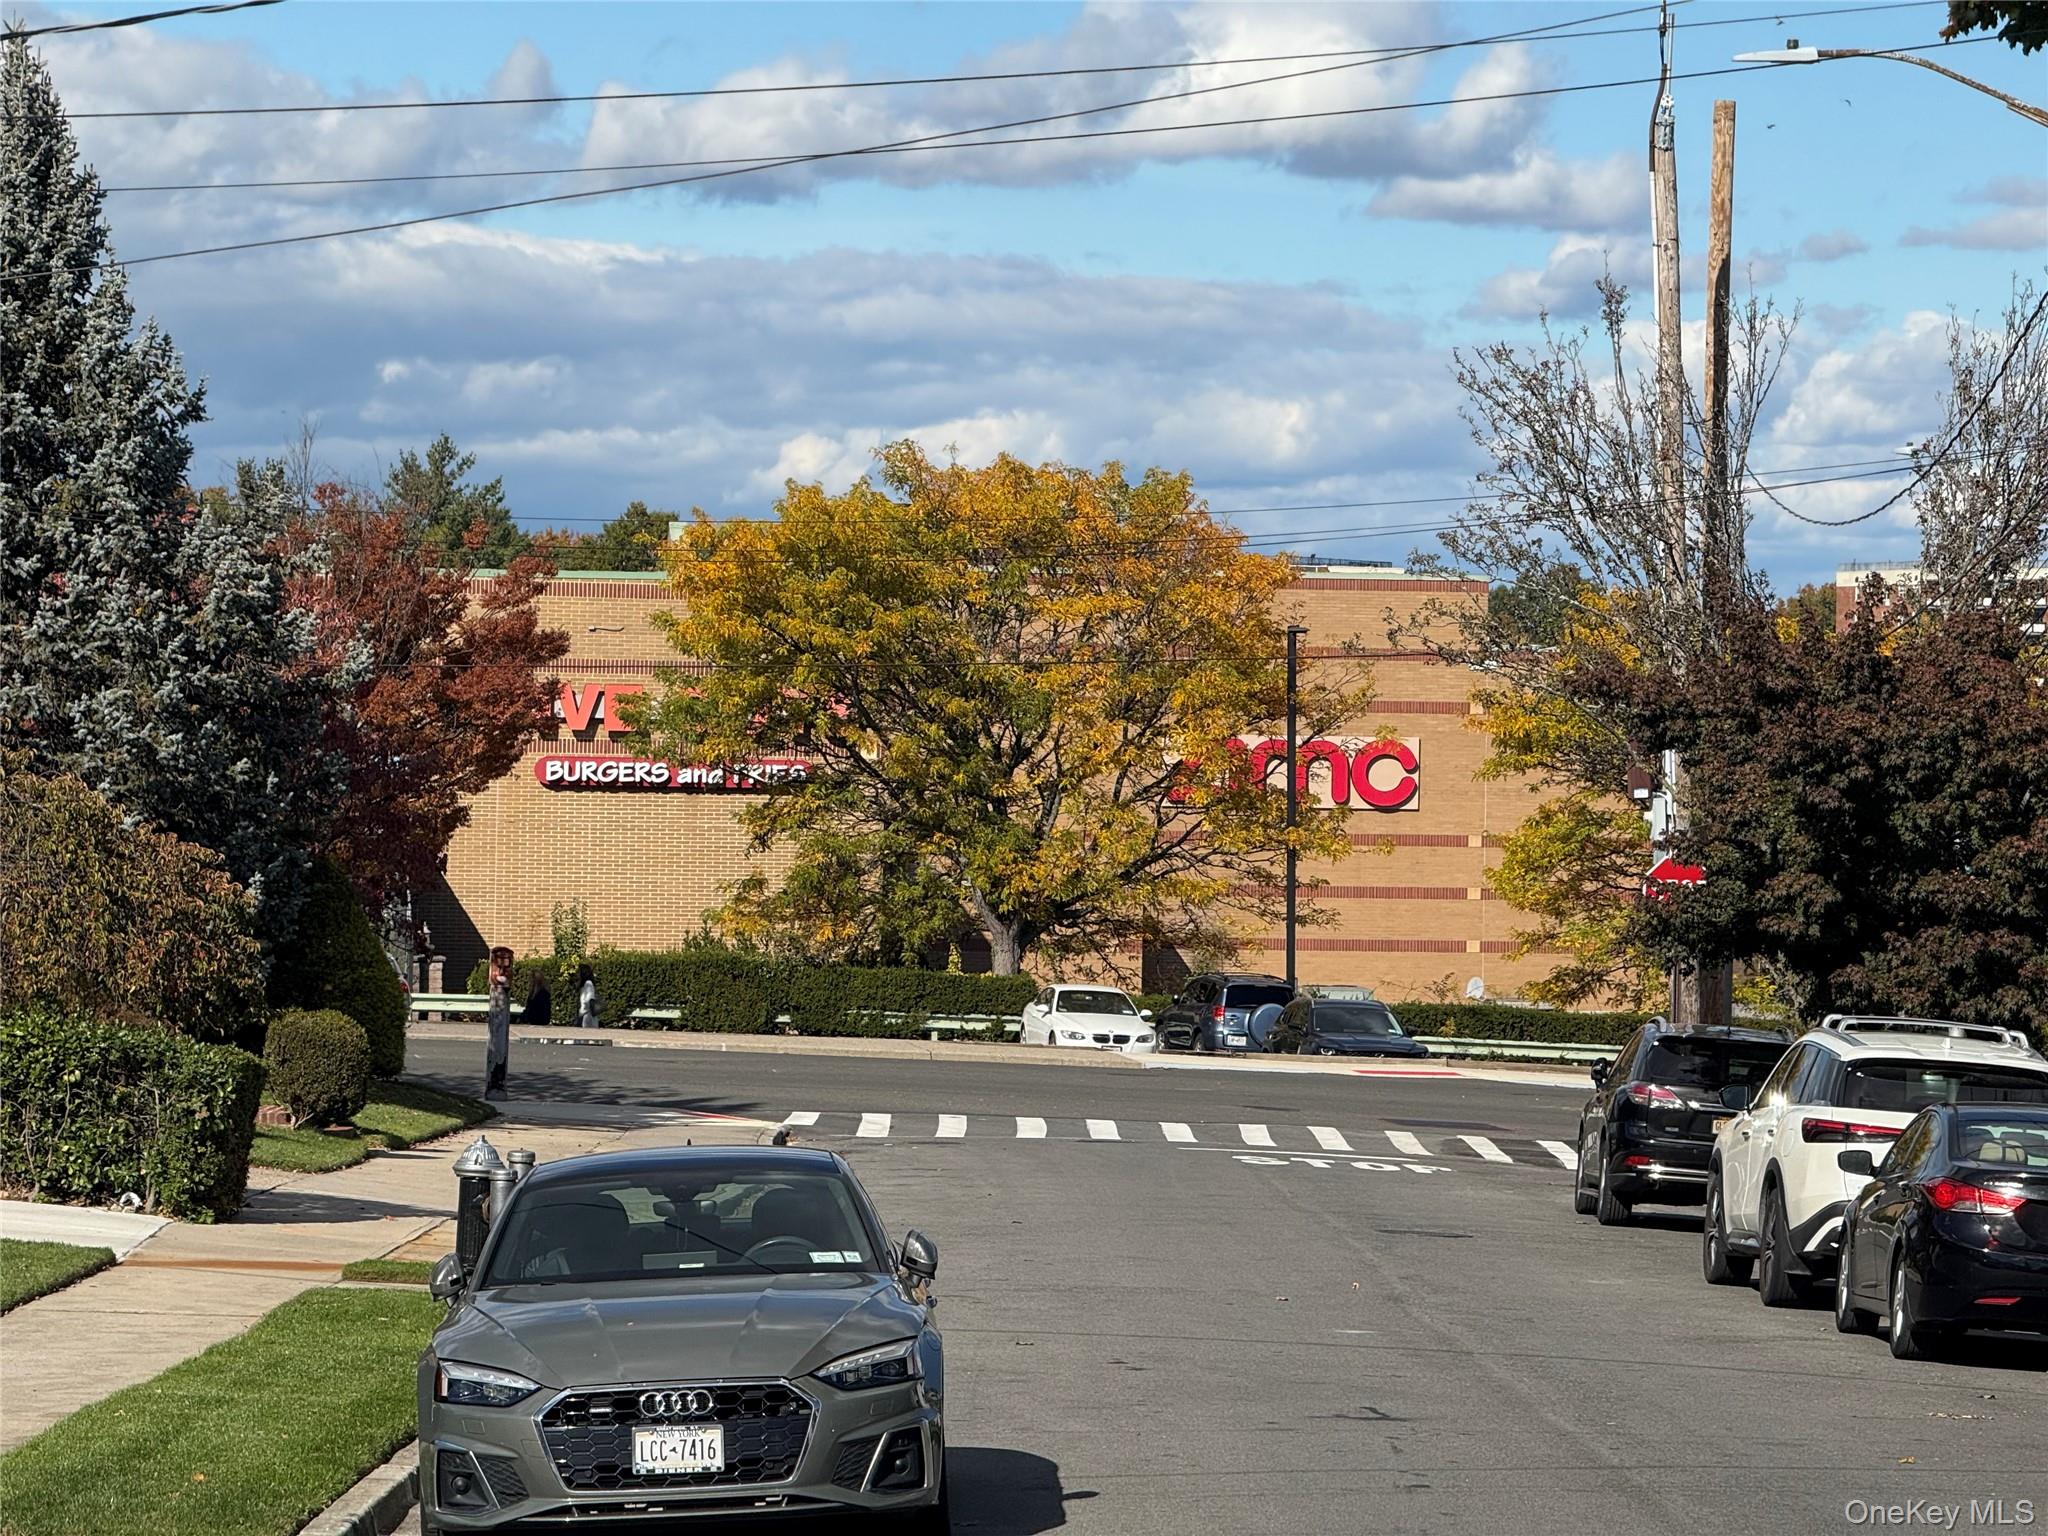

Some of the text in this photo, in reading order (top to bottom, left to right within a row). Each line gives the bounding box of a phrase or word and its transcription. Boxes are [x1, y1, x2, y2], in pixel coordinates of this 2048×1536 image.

[545, 761, 669, 784] BURGERS
[677, 763, 723, 784] and
[1232, 1155, 1454, 1174] STOP
[656, 1429, 701, 1439] NEW YORK
